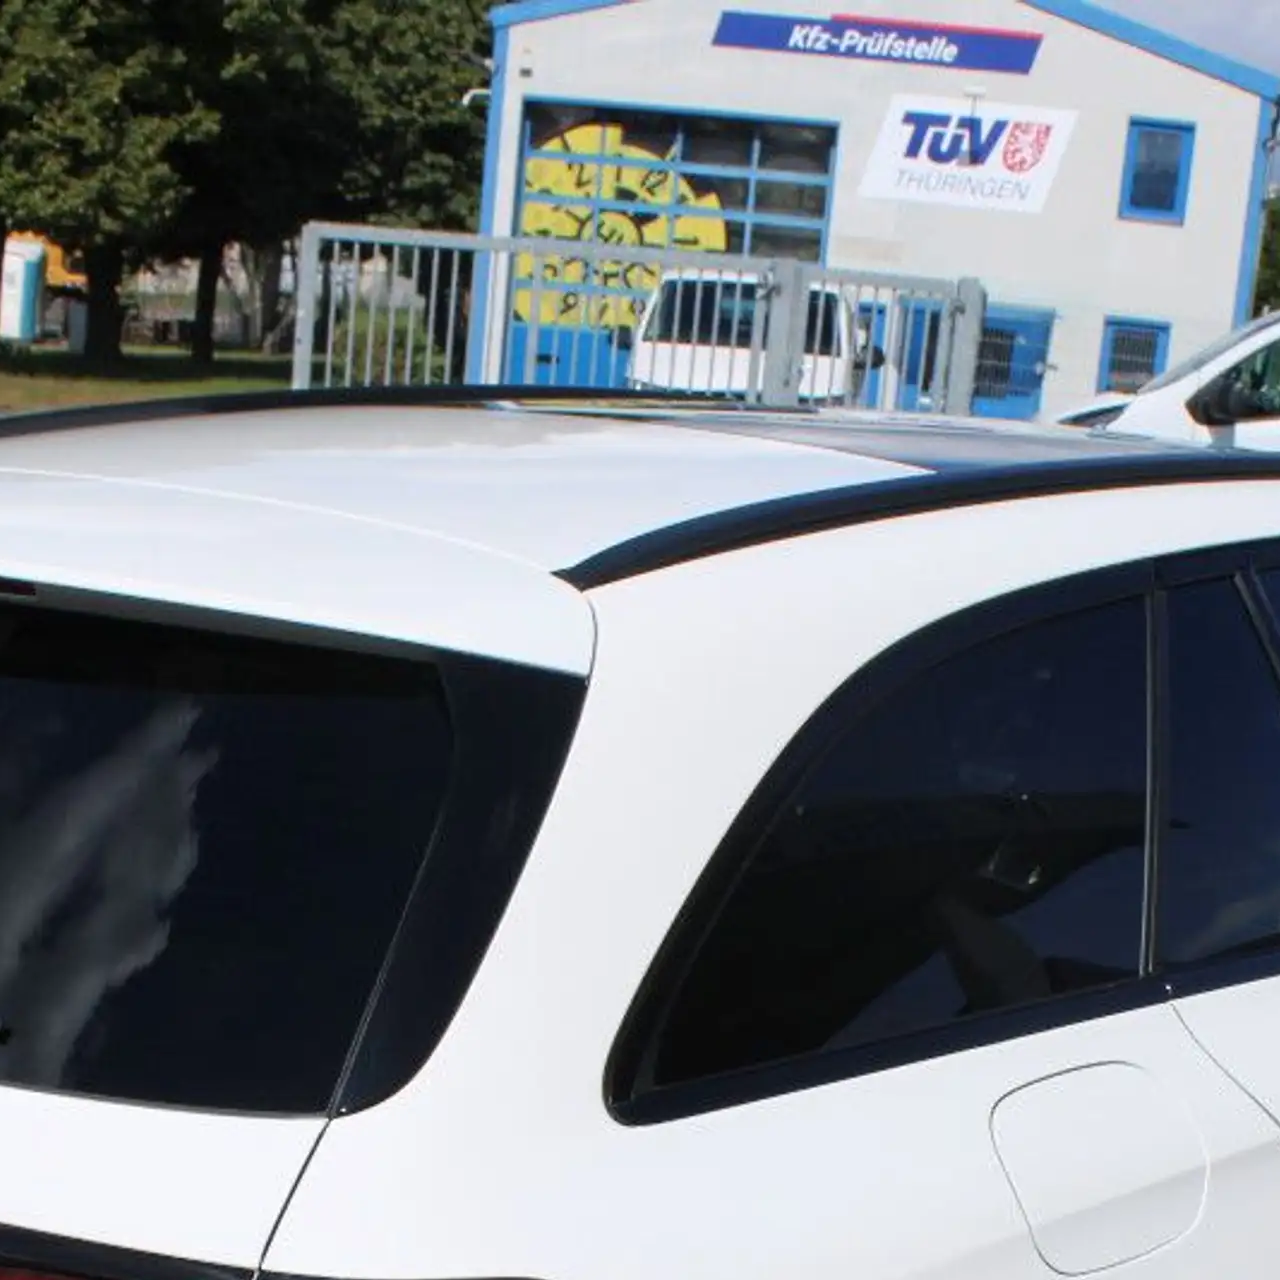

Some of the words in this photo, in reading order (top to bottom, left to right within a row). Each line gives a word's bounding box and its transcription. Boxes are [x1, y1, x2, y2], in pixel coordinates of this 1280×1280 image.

[788, 24, 959, 62] Kfz-Prüfstelle
[902, 110, 1008, 166] TÜV
[896, 169, 1031, 200] THÜRINGEN
